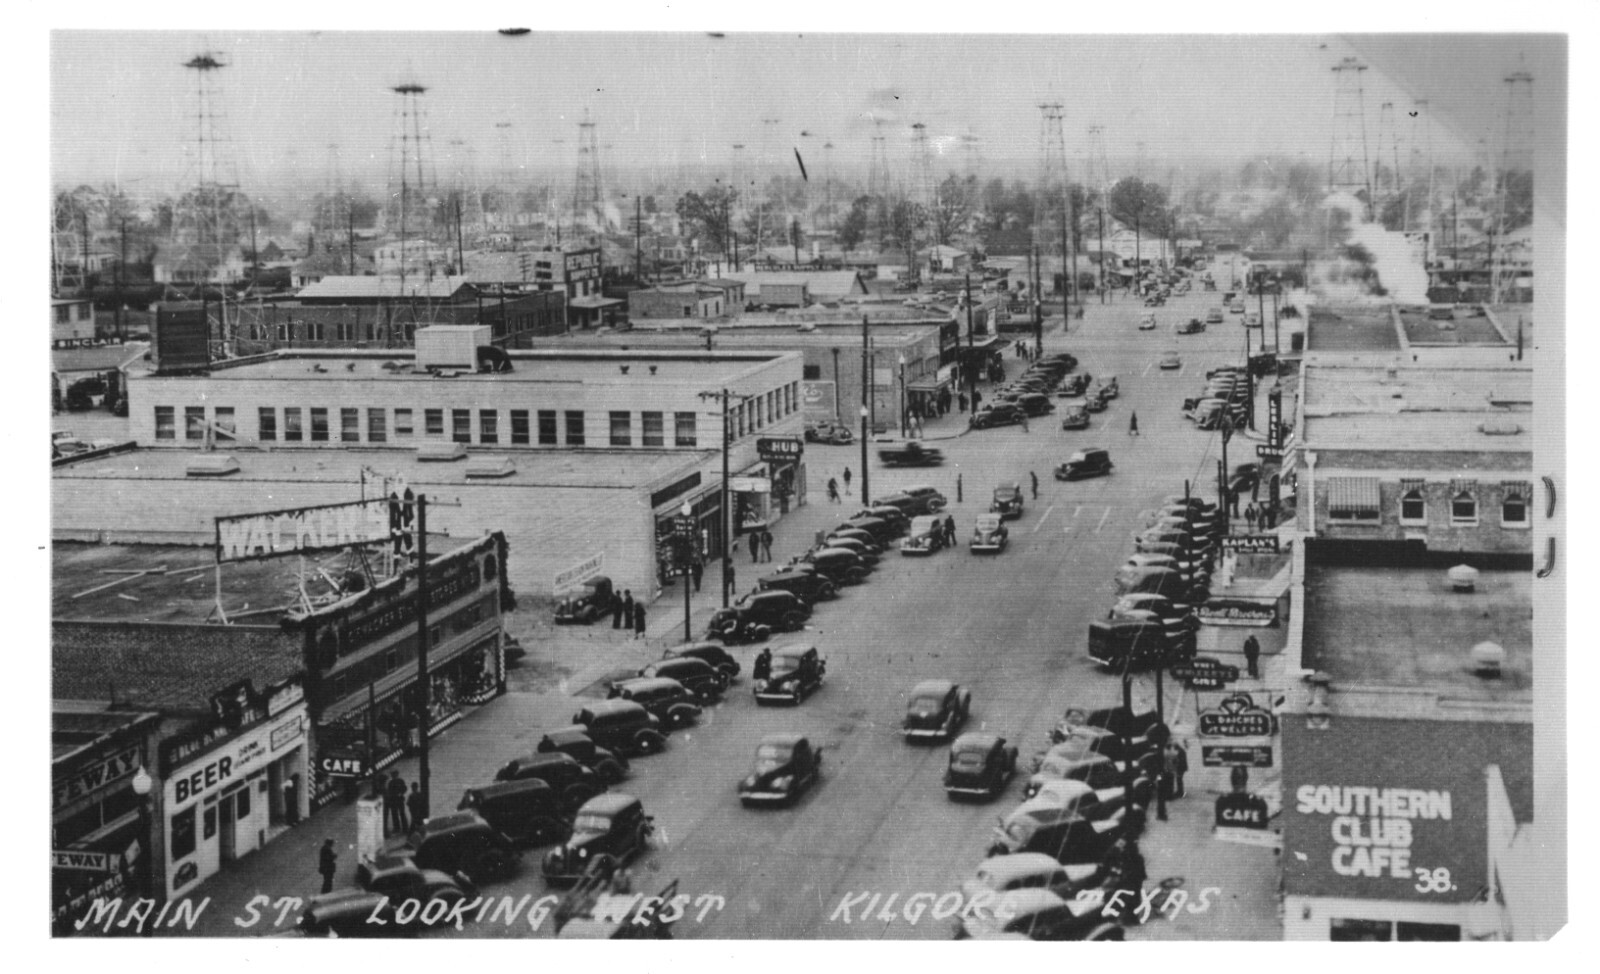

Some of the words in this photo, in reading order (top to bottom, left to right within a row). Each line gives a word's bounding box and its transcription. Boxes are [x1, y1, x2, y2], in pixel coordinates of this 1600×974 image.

[59, 337, 121, 348] SINCLAIR
[771, 441, 799, 453] HUB
[1222, 538, 1275, 547] KAPLAN'S
[322, 758, 361, 773] CAFE
[175, 755, 232, 805] BEER
[1297, 785, 1452, 820] SOUTHERN
[1222, 808, 1259, 822] CAFE
[1331, 816, 1413, 849] CLUB
[52, 853, 106, 869] EWAY
[1331, 847, 1412, 878] CAFE
